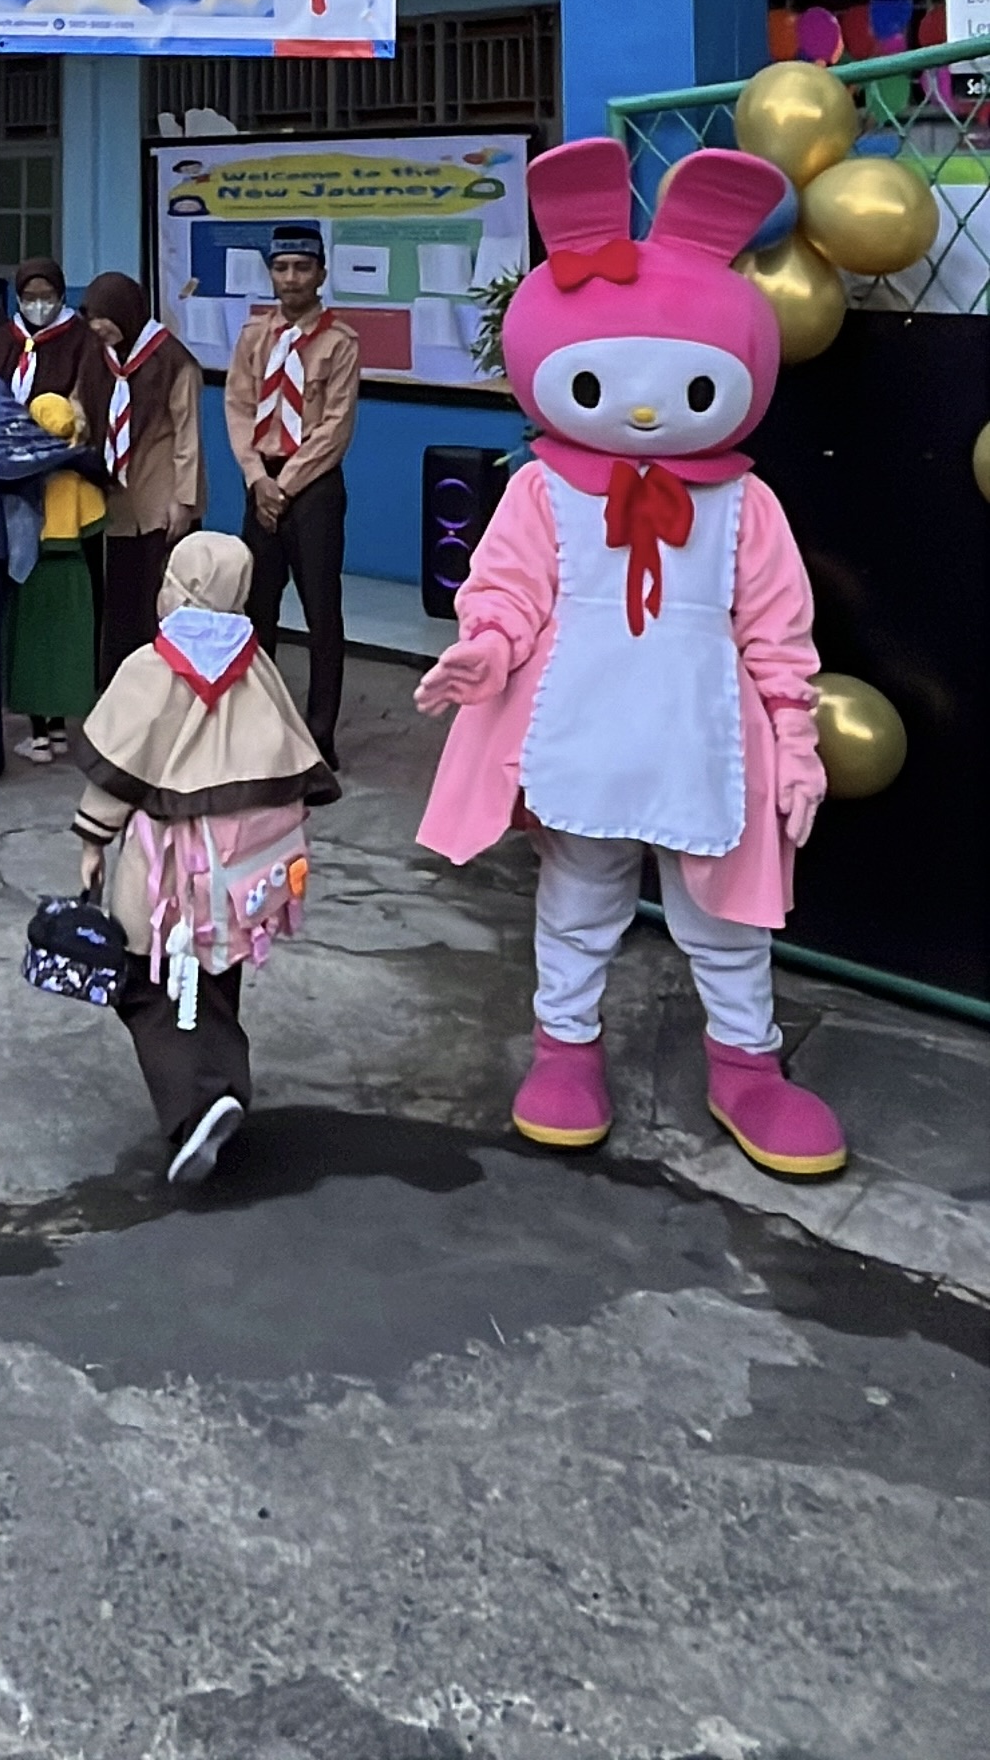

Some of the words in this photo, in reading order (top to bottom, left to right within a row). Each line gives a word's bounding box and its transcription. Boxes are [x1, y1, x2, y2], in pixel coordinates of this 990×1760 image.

[221, 171, 342, 182] Welcome
[352, 168, 381, 179] to
[391, 166, 441, 178] the
[217, 185, 289, 200] New
[299, 183, 453, 199] Journey
